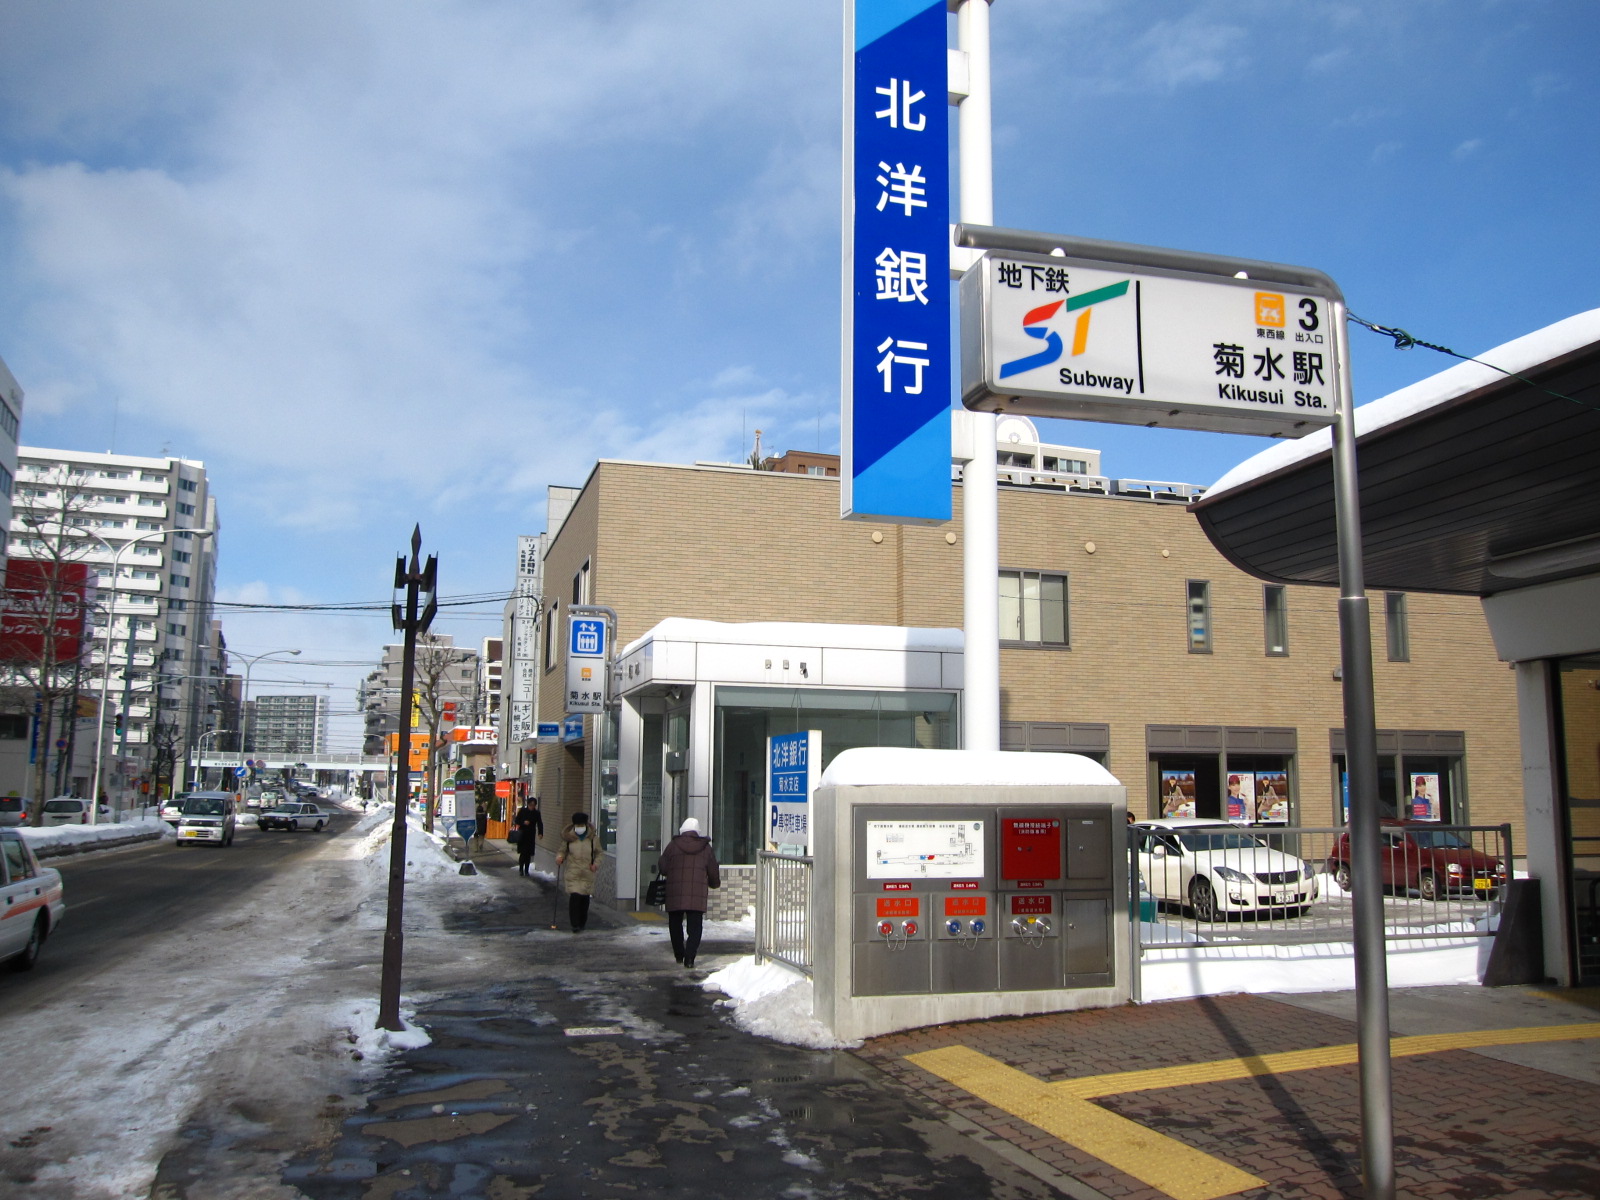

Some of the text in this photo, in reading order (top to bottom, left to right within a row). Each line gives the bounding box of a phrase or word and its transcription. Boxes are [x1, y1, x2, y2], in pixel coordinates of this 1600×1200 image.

[875, 77, 930, 396] 北洋銀行
[998, 261, 1070, 294] 地下鉄
[1298, 297, 1320, 332] 3
[1256, 327, 1286, 341] 東西線
[1295, 331, 1324, 345] 出入口
[1212, 342, 1325, 387] 菊水駅
[1059, 367, 1135, 395] Subway
[1218, 383, 1327, 409] Kikusui Sta.
[569, 691, 602, 700] 菊水駅
[512, 704, 521, 742] 札幌支店
[773, 739, 807, 768] 北洋銀行
[778, 776, 799, 792] 菊水支店
[778, 813, 808, 835] 専用駐車場
[1018, 897, 1045, 905] 送水口
